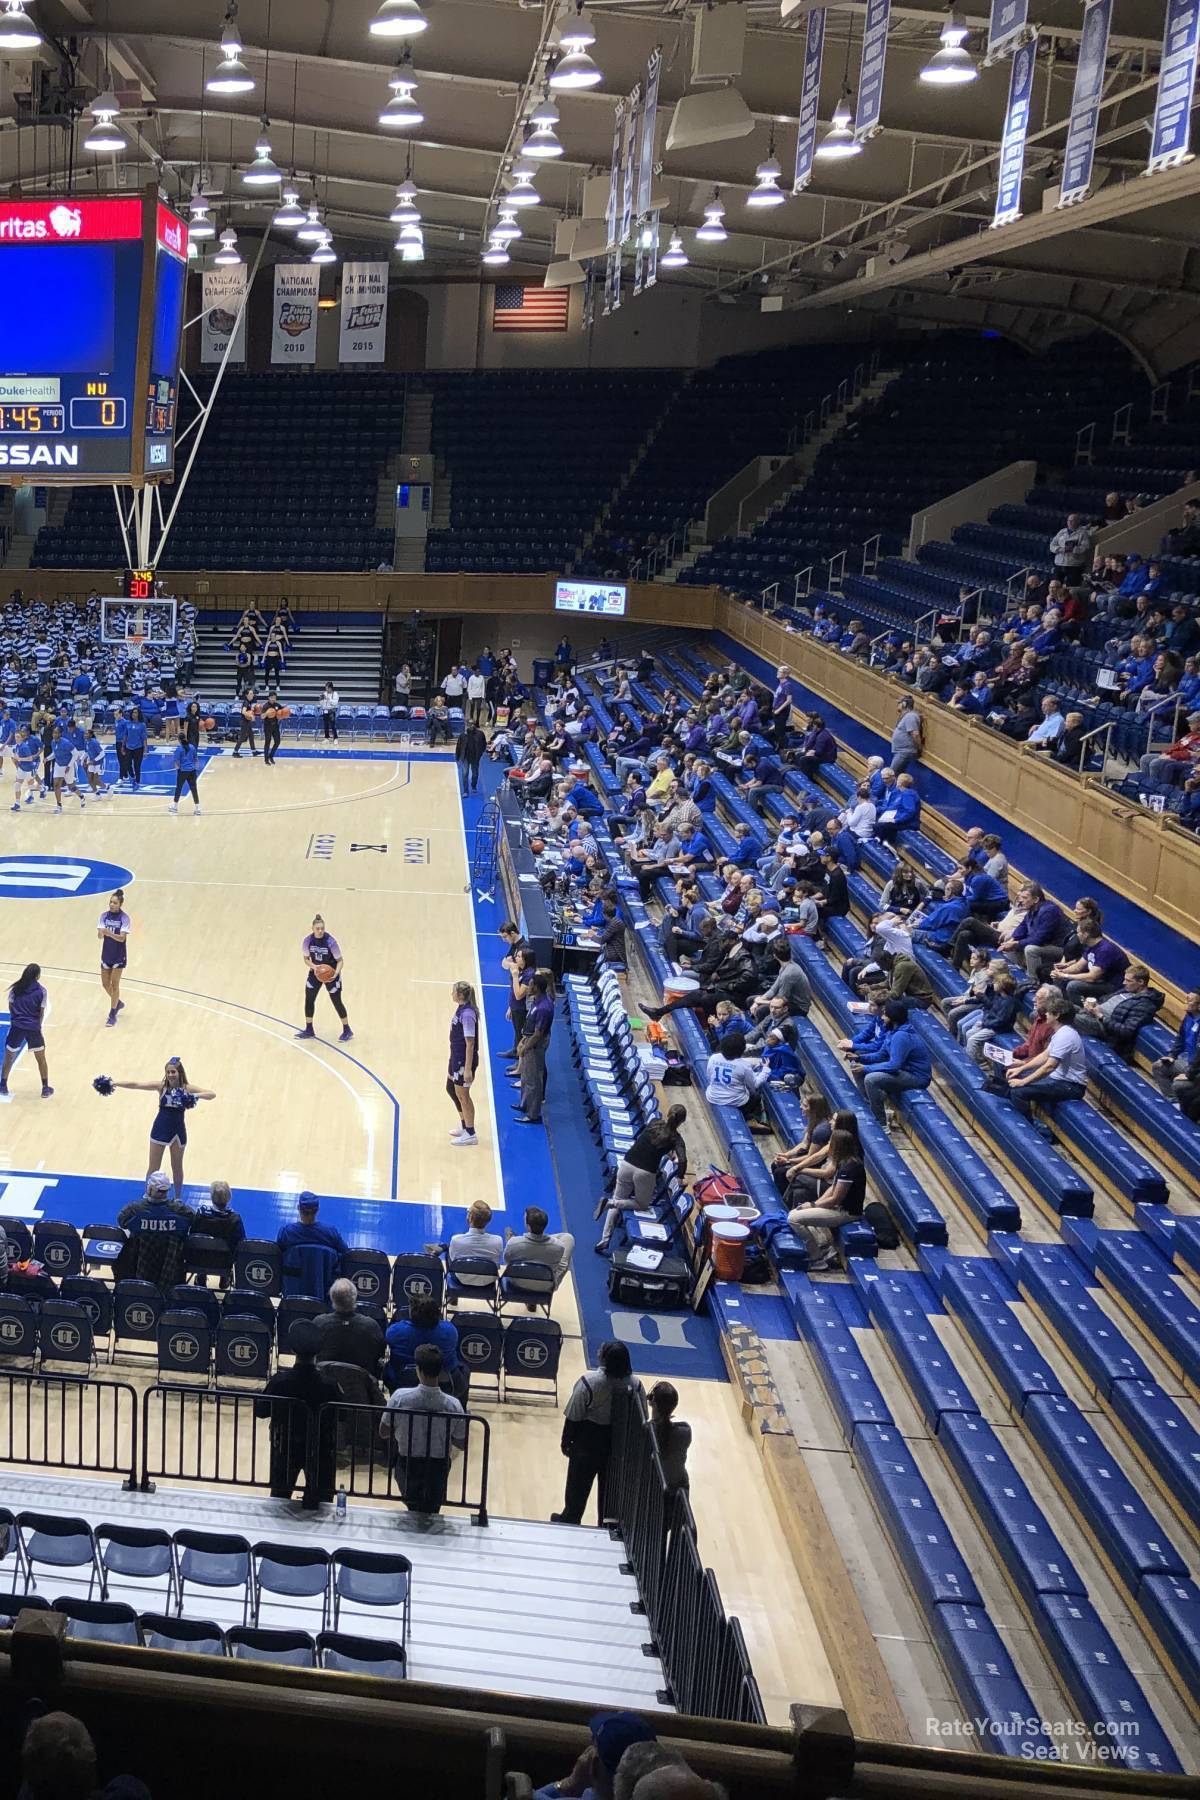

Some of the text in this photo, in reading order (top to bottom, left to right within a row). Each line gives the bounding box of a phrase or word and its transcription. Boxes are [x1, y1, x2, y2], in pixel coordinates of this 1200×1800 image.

[280, 276, 314, 286] NATIONAL
[276, 287, 317, 297] CHAMPIONS
[214, 343, 230, 352] 200
[284, 344, 305, 352] 2010
[352, 342, 373, 351] 2015
[87, 383, 107, 396] NU
[43, 409, 63, 417] PERIOD
[102, 401, 115, 425] 0
[130, 581, 148, 597] 30
[714, 1066, 733, 1085] 15
[140, 1218, 177, 1232] DUKE
